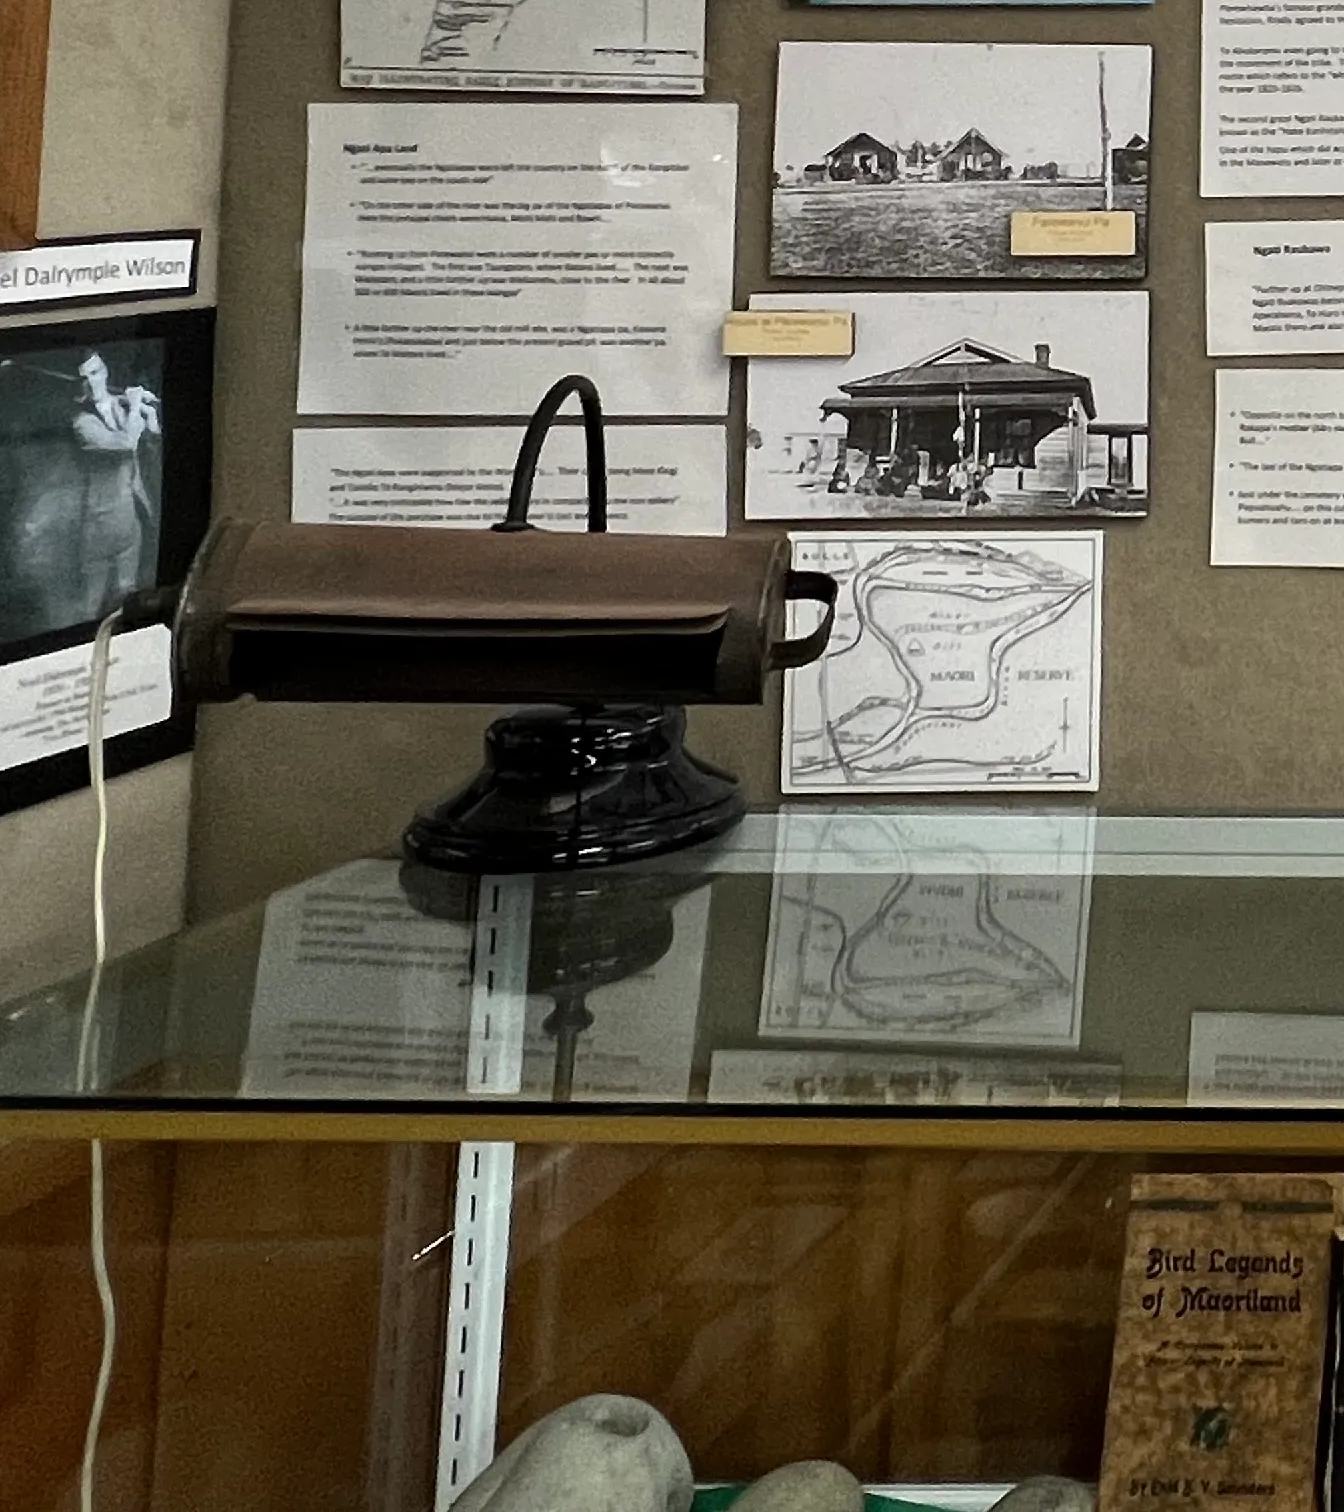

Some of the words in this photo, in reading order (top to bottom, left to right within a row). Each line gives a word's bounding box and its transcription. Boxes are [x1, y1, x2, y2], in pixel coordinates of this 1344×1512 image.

[25, 260, 121, 287] Dalrymple
[126, 257, 186, 277] Wilson
[1146, 1247, 1197, 1280] Bird
[1207, 1248, 1304, 1280] Legends
[1141, 1286, 1165, 1319] of
[1175, 1286, 1302, 1319] Maoriland
